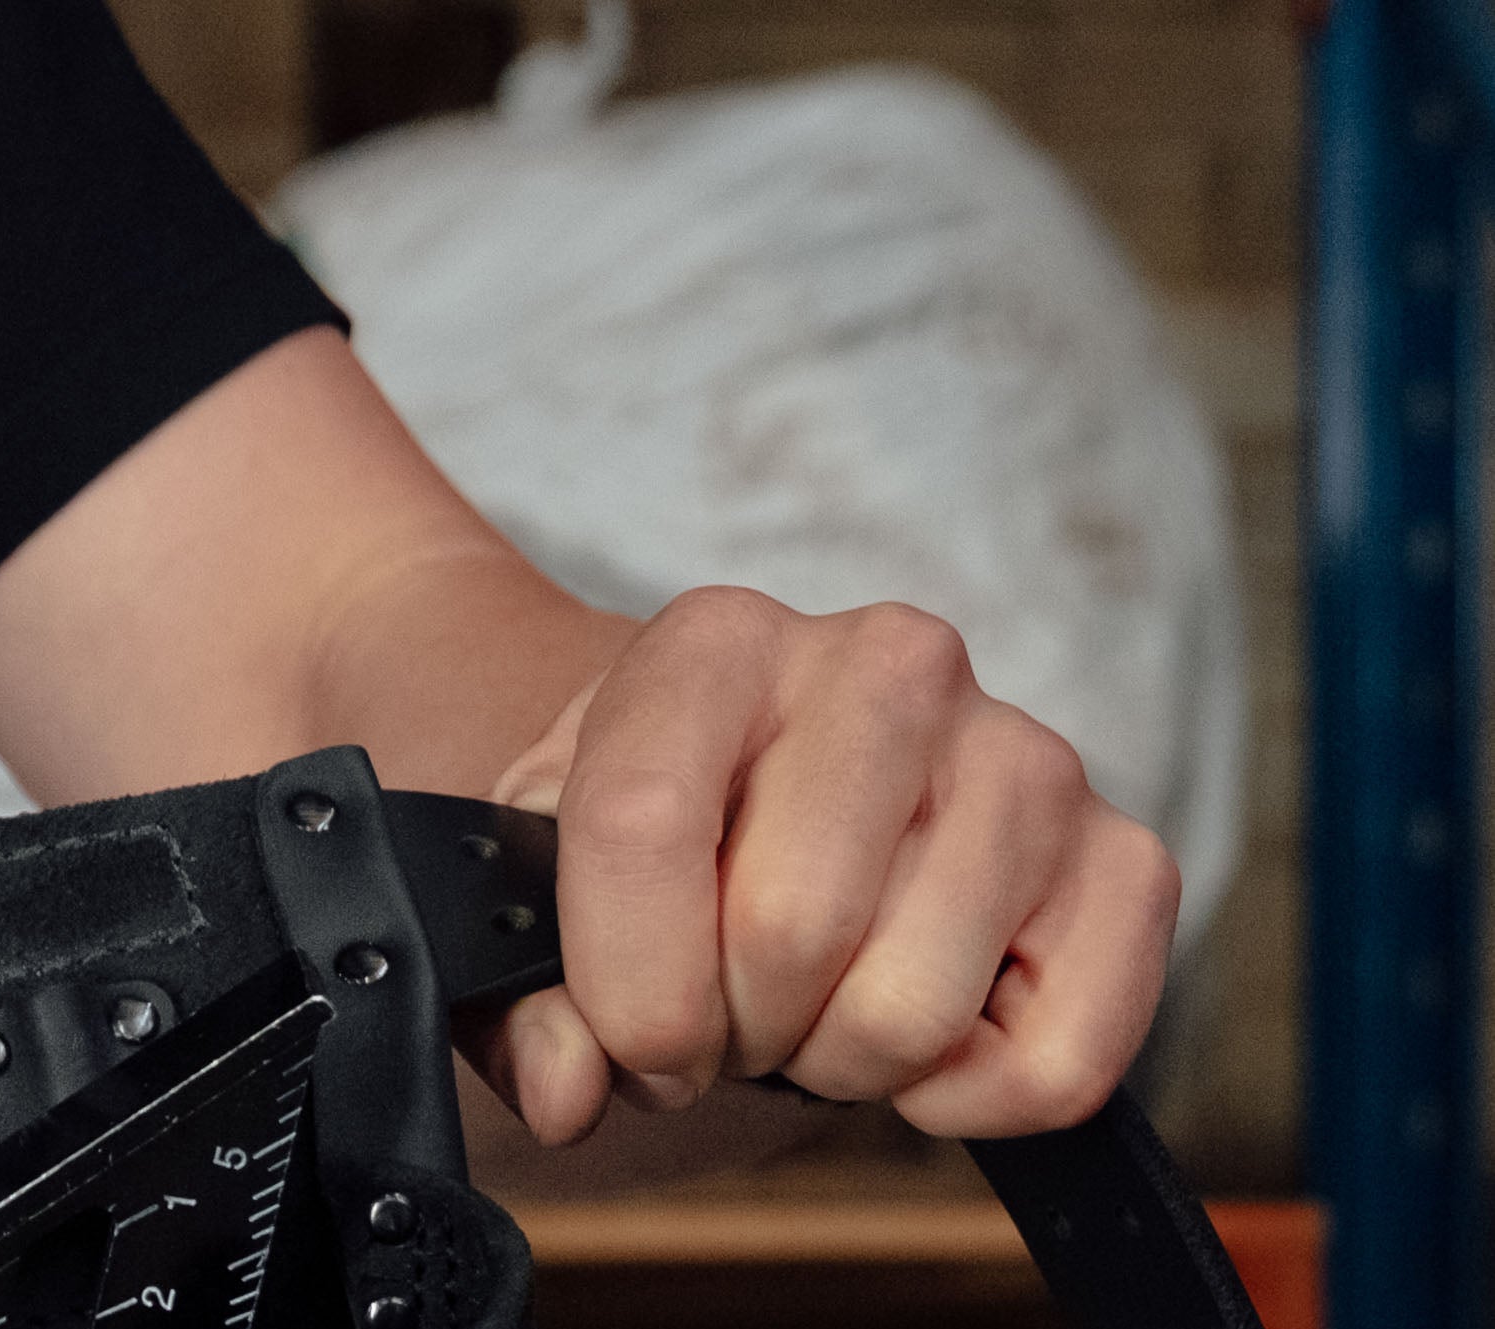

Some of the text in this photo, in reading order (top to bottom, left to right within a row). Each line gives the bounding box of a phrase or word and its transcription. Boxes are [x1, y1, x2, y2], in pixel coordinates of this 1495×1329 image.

[213, 1146, 247, 1170] 5
[163, 1194, 197, 1210] 1
[141, 1285, 175, 1311] 2
